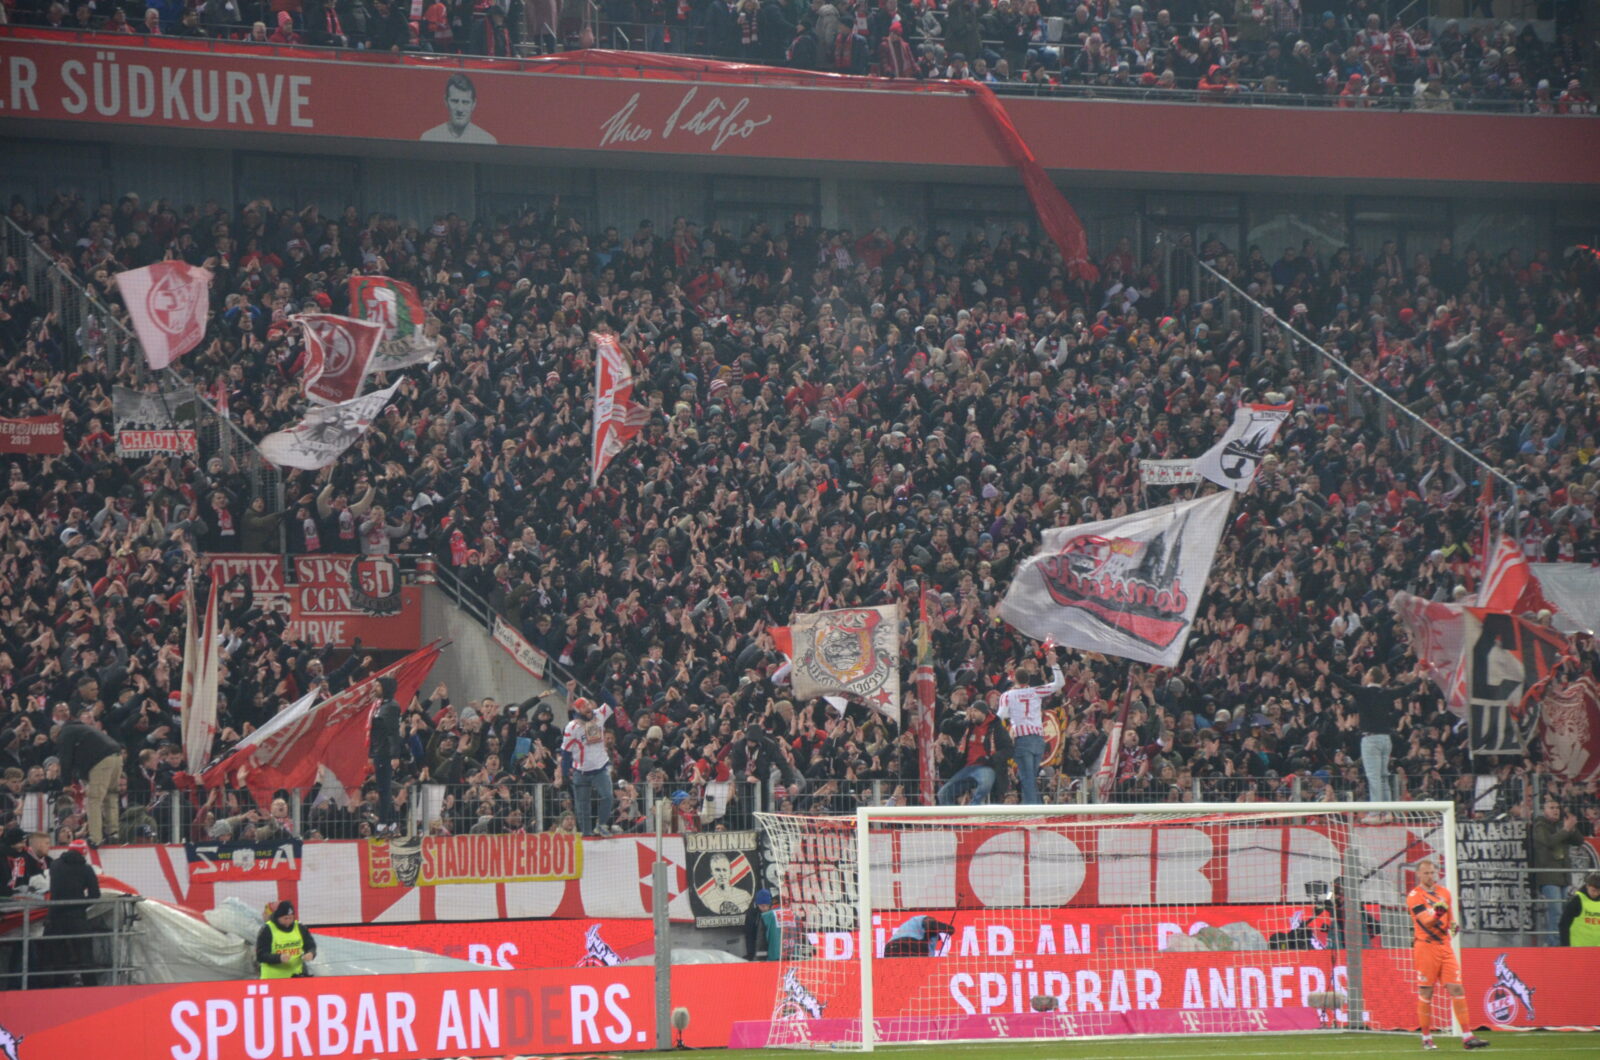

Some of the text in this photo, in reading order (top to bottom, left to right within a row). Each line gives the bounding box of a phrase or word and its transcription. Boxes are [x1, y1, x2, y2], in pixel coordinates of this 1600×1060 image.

[0, 52, 314, 128] R SÜDKURVE
[300, 559, 351, 583] SPS
[287, 620, 346, 644] URVE
[1019, 698, 1030, 716] 7
[688, 832, 757, 851] DOMINIK
[1455, 822, 1527, 841] VIRAGE
[422, 834, 575, 881] STADIONVERBOT
[1456, 841, 1527, 860] AUTEUIL
[950, 959, 1163, 1014] SPÜRBAR
[169, 983, 648, 1060] SPÜRBAR ANDERS.
